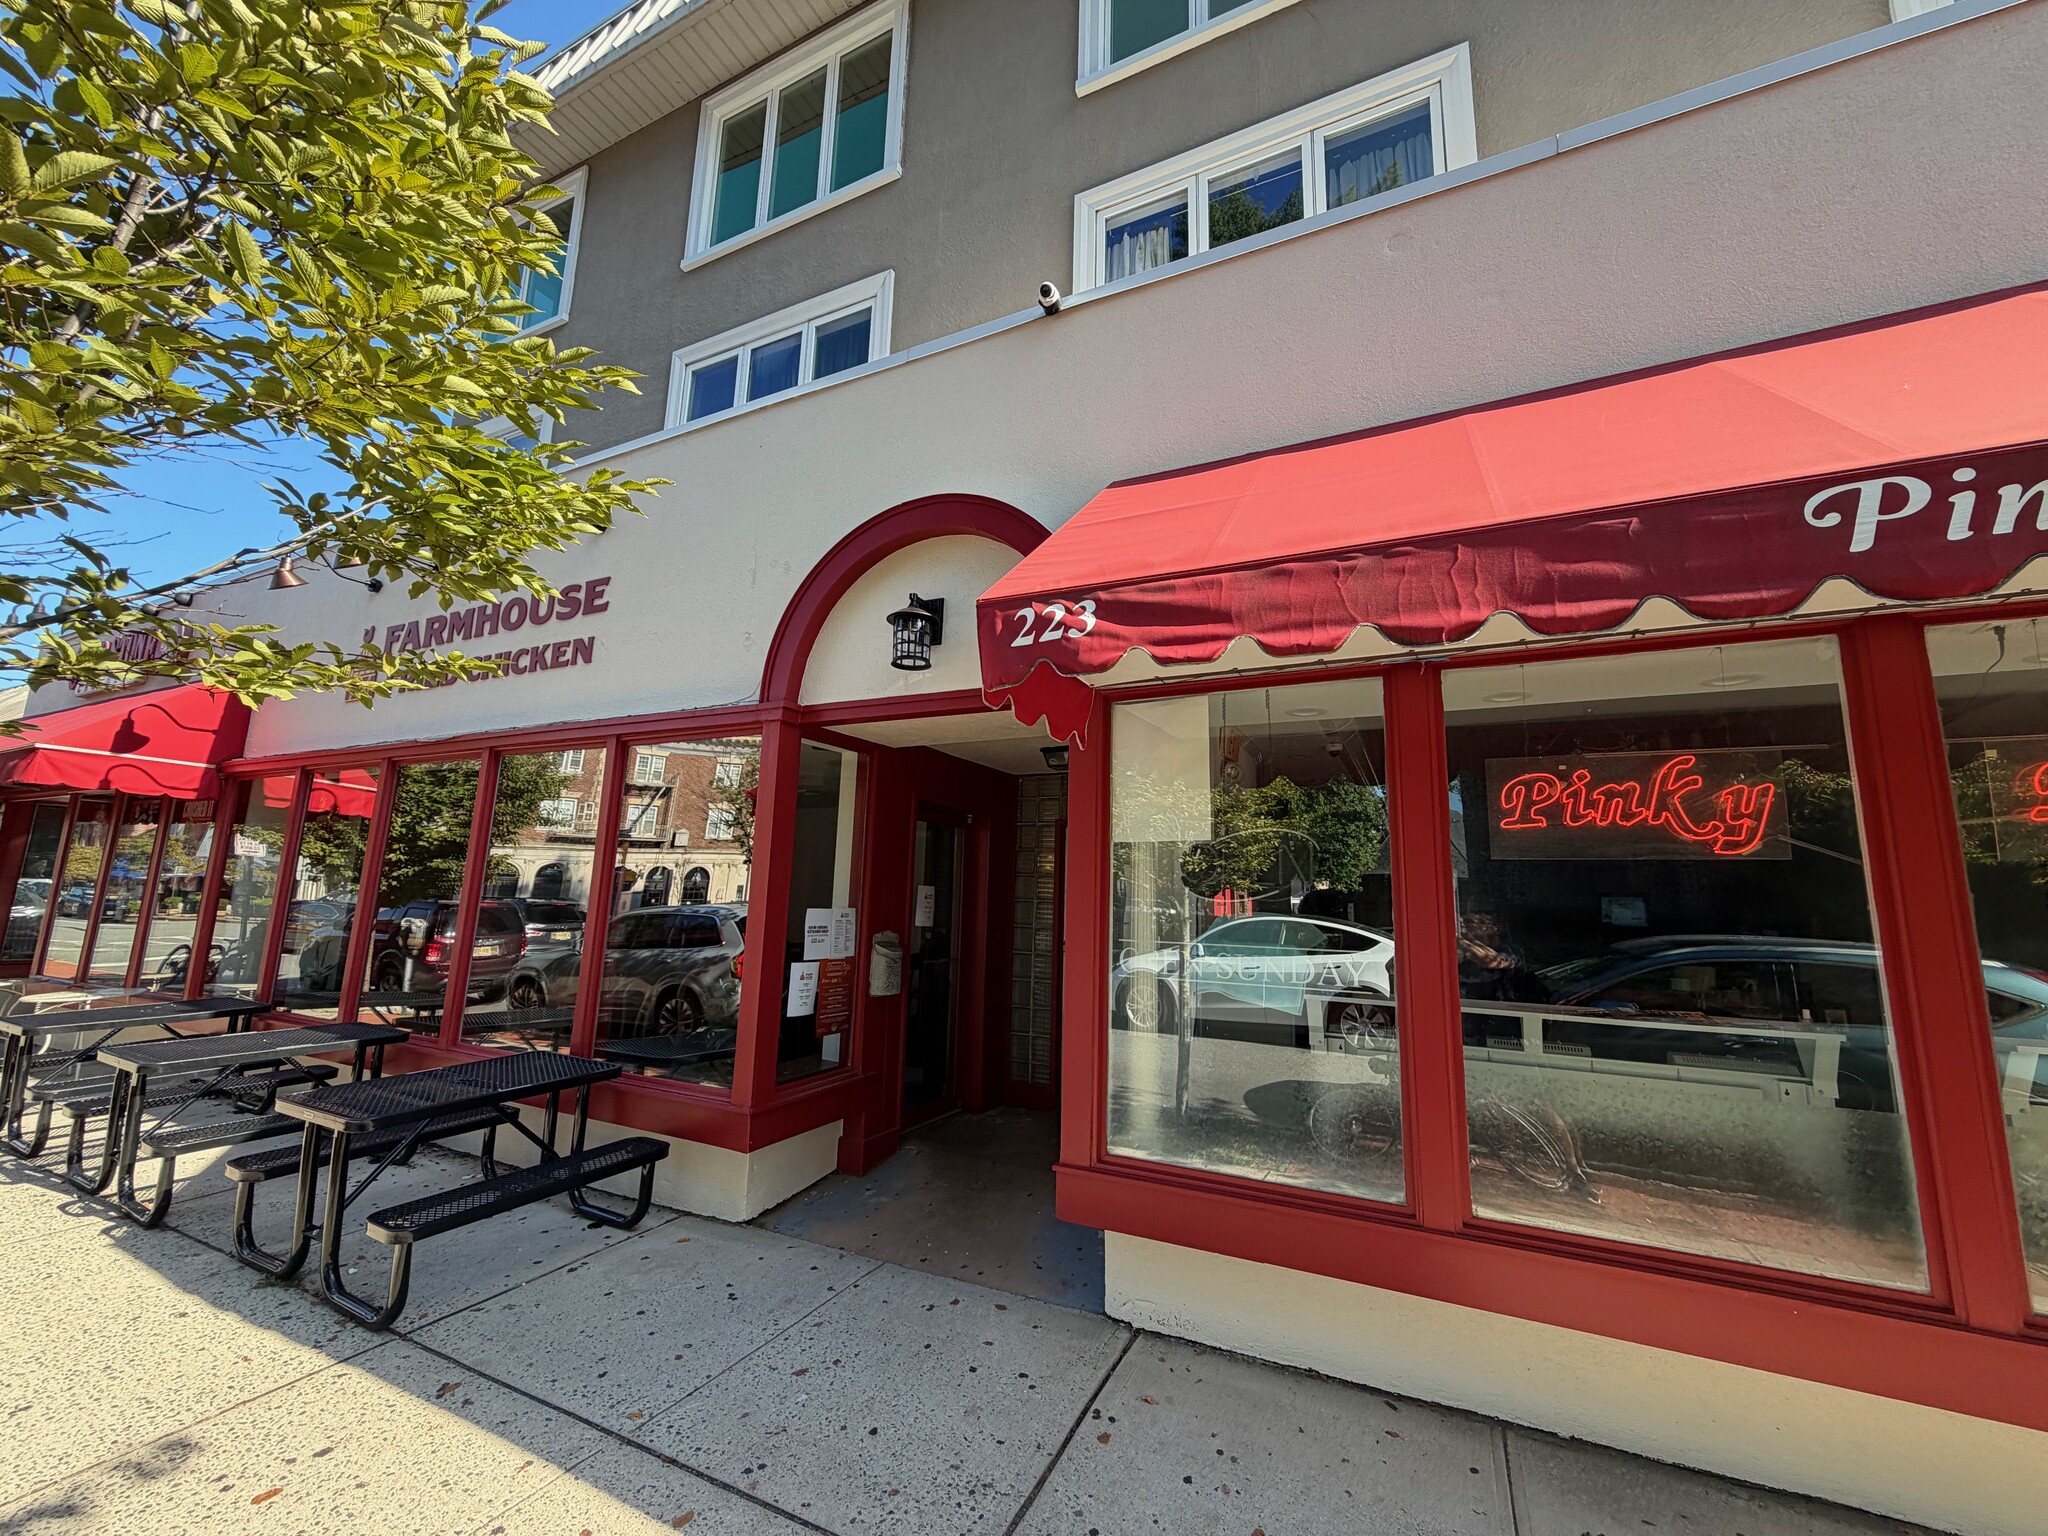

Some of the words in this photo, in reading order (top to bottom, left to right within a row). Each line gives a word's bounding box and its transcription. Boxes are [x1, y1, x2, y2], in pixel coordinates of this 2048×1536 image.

[383, 576, 611, 655] FARMHOUSE
[1010, 599, 1097, 648] 223
[1500, 755, 1775, 854] Pinky
[1119, 947, 1204, 979] OEN
[1216, 953, 1366, 988] SUNDAY
